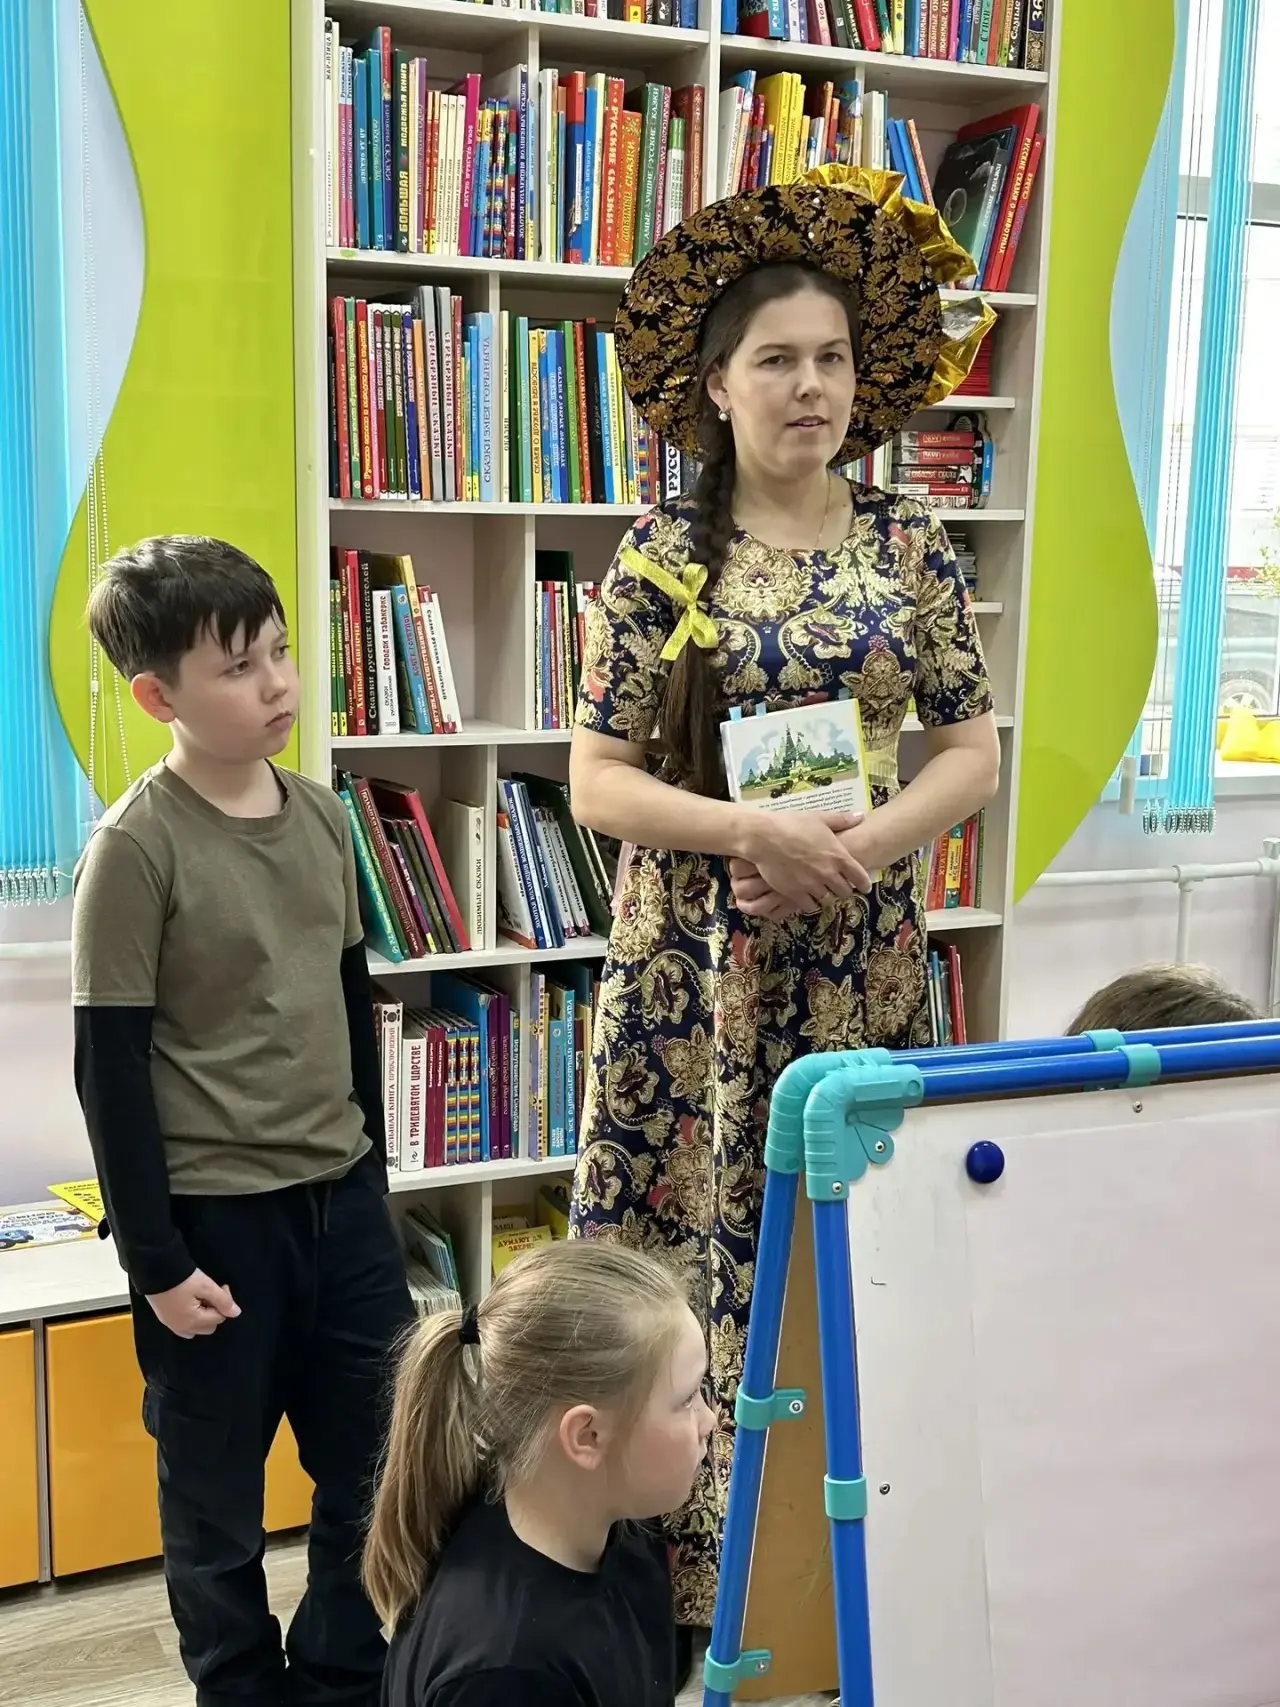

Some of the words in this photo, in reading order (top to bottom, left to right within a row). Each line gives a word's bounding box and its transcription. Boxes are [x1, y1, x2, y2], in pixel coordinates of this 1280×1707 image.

[919, 12, 928, 50] ЛЮБИМЫЕ
[930, 14, 939, 52] ЛЮБИМЫЕ
[939, 14, 949, 54] ЛЮБИМЫЕ
[980, 10, 991, 42] СТИХИ
[325, 36, 334, 80] ЖАР-ПТИЦА
[649, 87, 660, 126] СКАЗКИ
[519, 114, 527, 159] ВОЛШЕБНЫХ
[608, 106, 619, 164] РУССКИЕ
[646, 127, 657, 170] РУССКИЕ
[1018, 138, 1032, 172] РУССКИЕ
[384, 144, 392, 181] СКАЗКИ
[624, 140, 636, 187] СКАЗКИ
[398, 171, 409, 233] БОЛЬШАЯ
[606, 168, 617, 224] СКАЗКИ
[644, 171, 654, 211] ЛУЧШИЕ
[1012, 172, 1026, 201] СКАЗКИ
[621, 192, 632, 244] ЛЮБИМЫЕ
[642, 212, 652, 246] САМЫЕ
[999, 210, 1015, 255] ЖИВОТНЫХ
[428, 331, 438, 407] СЕРЕБРЯНЫЕ
[443, 331, 453, 407] СЕРЕБРЯНЫЕ
[481, 336, 491, 403] ГОРЫНЫЧА
[578, 351, 588, 410] ЖИВОТНЫХ
[432, 412, 441, 458] СКАЗКИ
[446, 413, 454, 459] СКАЗКИ
[482, 406, 491, 437] ЗМЕЯ
[532, 407, 540, 437] ДРУЖБЕ
[581, 421, 590, 462] СКАЗКИ
[483, 438, 493, 483] СКАЗКИ
[667, 447, 679, 492] РУСС
[361, 562, 372, 623] писателей
[378, 595, 388, 633] табакерке
[426, 609, 435, 635] Сказки
[366, 625, 376, 672] русских
[381, 640, 391, 671] Городок
[430, 637, 439, 665] русских
[368, 676, 377, 719] Сказки
[508, 795, 519, 822] СКАЗОК
[531, 901, 542, 929] ЗОЛОТАЯ
[387, 1027, 396, 1081] ПРИКЛЮЧЕНИЙ
[411, 1045, 422, 1081] ЦАРСТВЕ
[387, 1084, 396, 1111] КНИГА
[409, 1084, 421, 1138] ТРИДЕВЯТОМ
[386, 1112, 395, 1153] БОЛЬШАЯ
